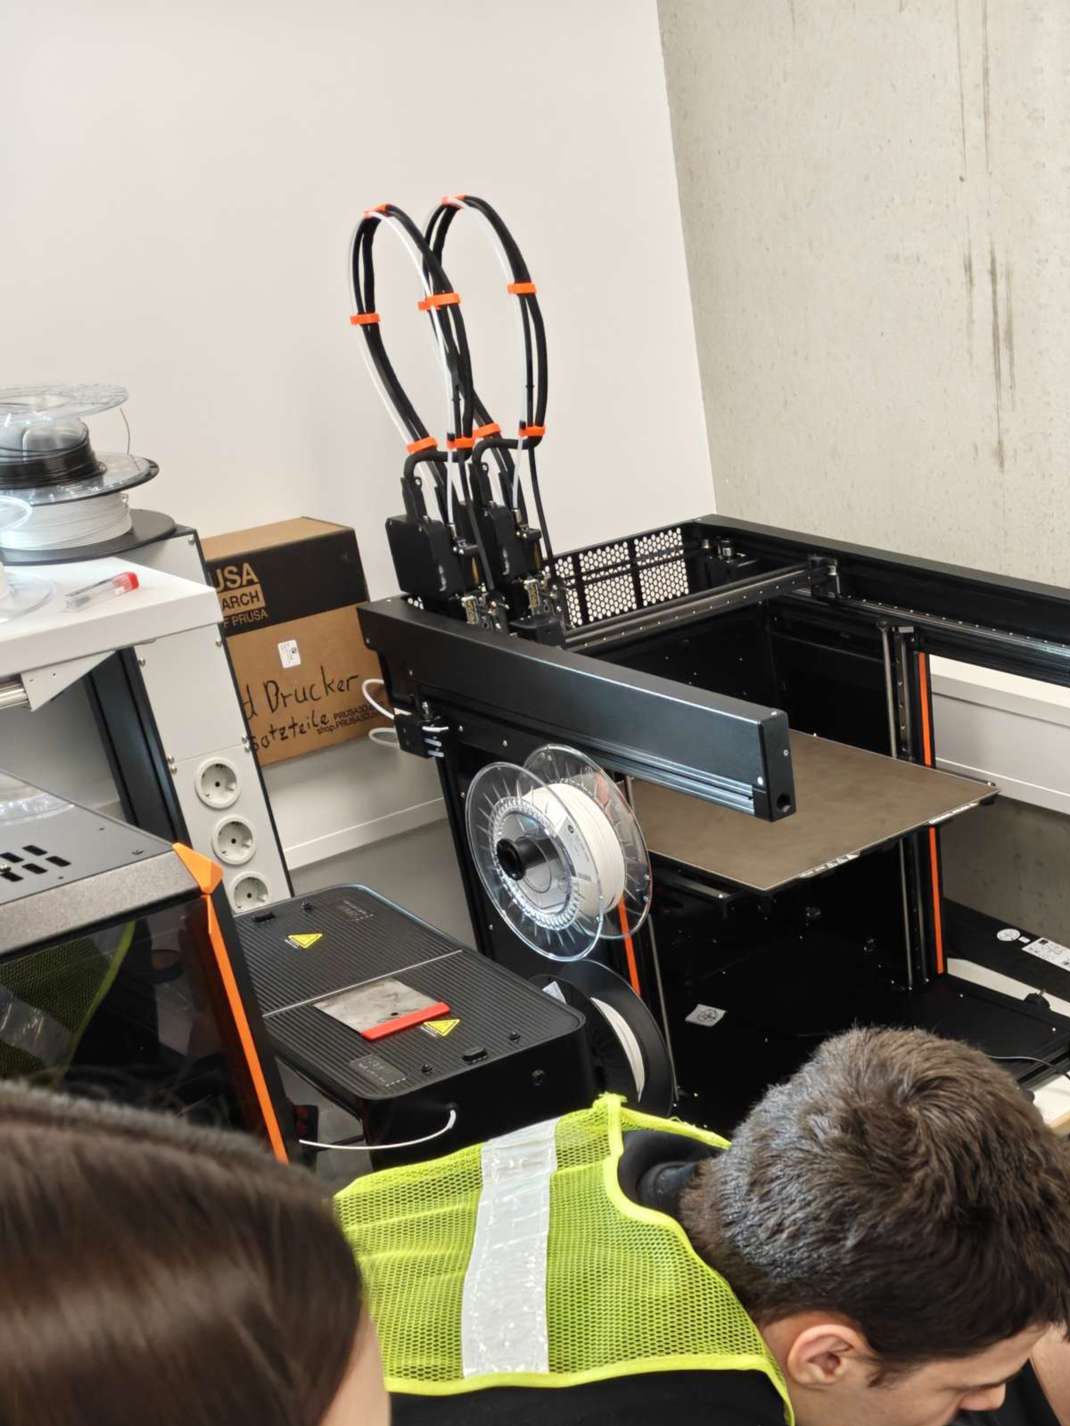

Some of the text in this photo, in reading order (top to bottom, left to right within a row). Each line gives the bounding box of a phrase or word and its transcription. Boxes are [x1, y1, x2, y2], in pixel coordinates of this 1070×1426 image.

[222, 590, 260, 609] ARCH
[231, 609, 269, 627] PRUSA
[262, 664, 360, 714] Drucker
